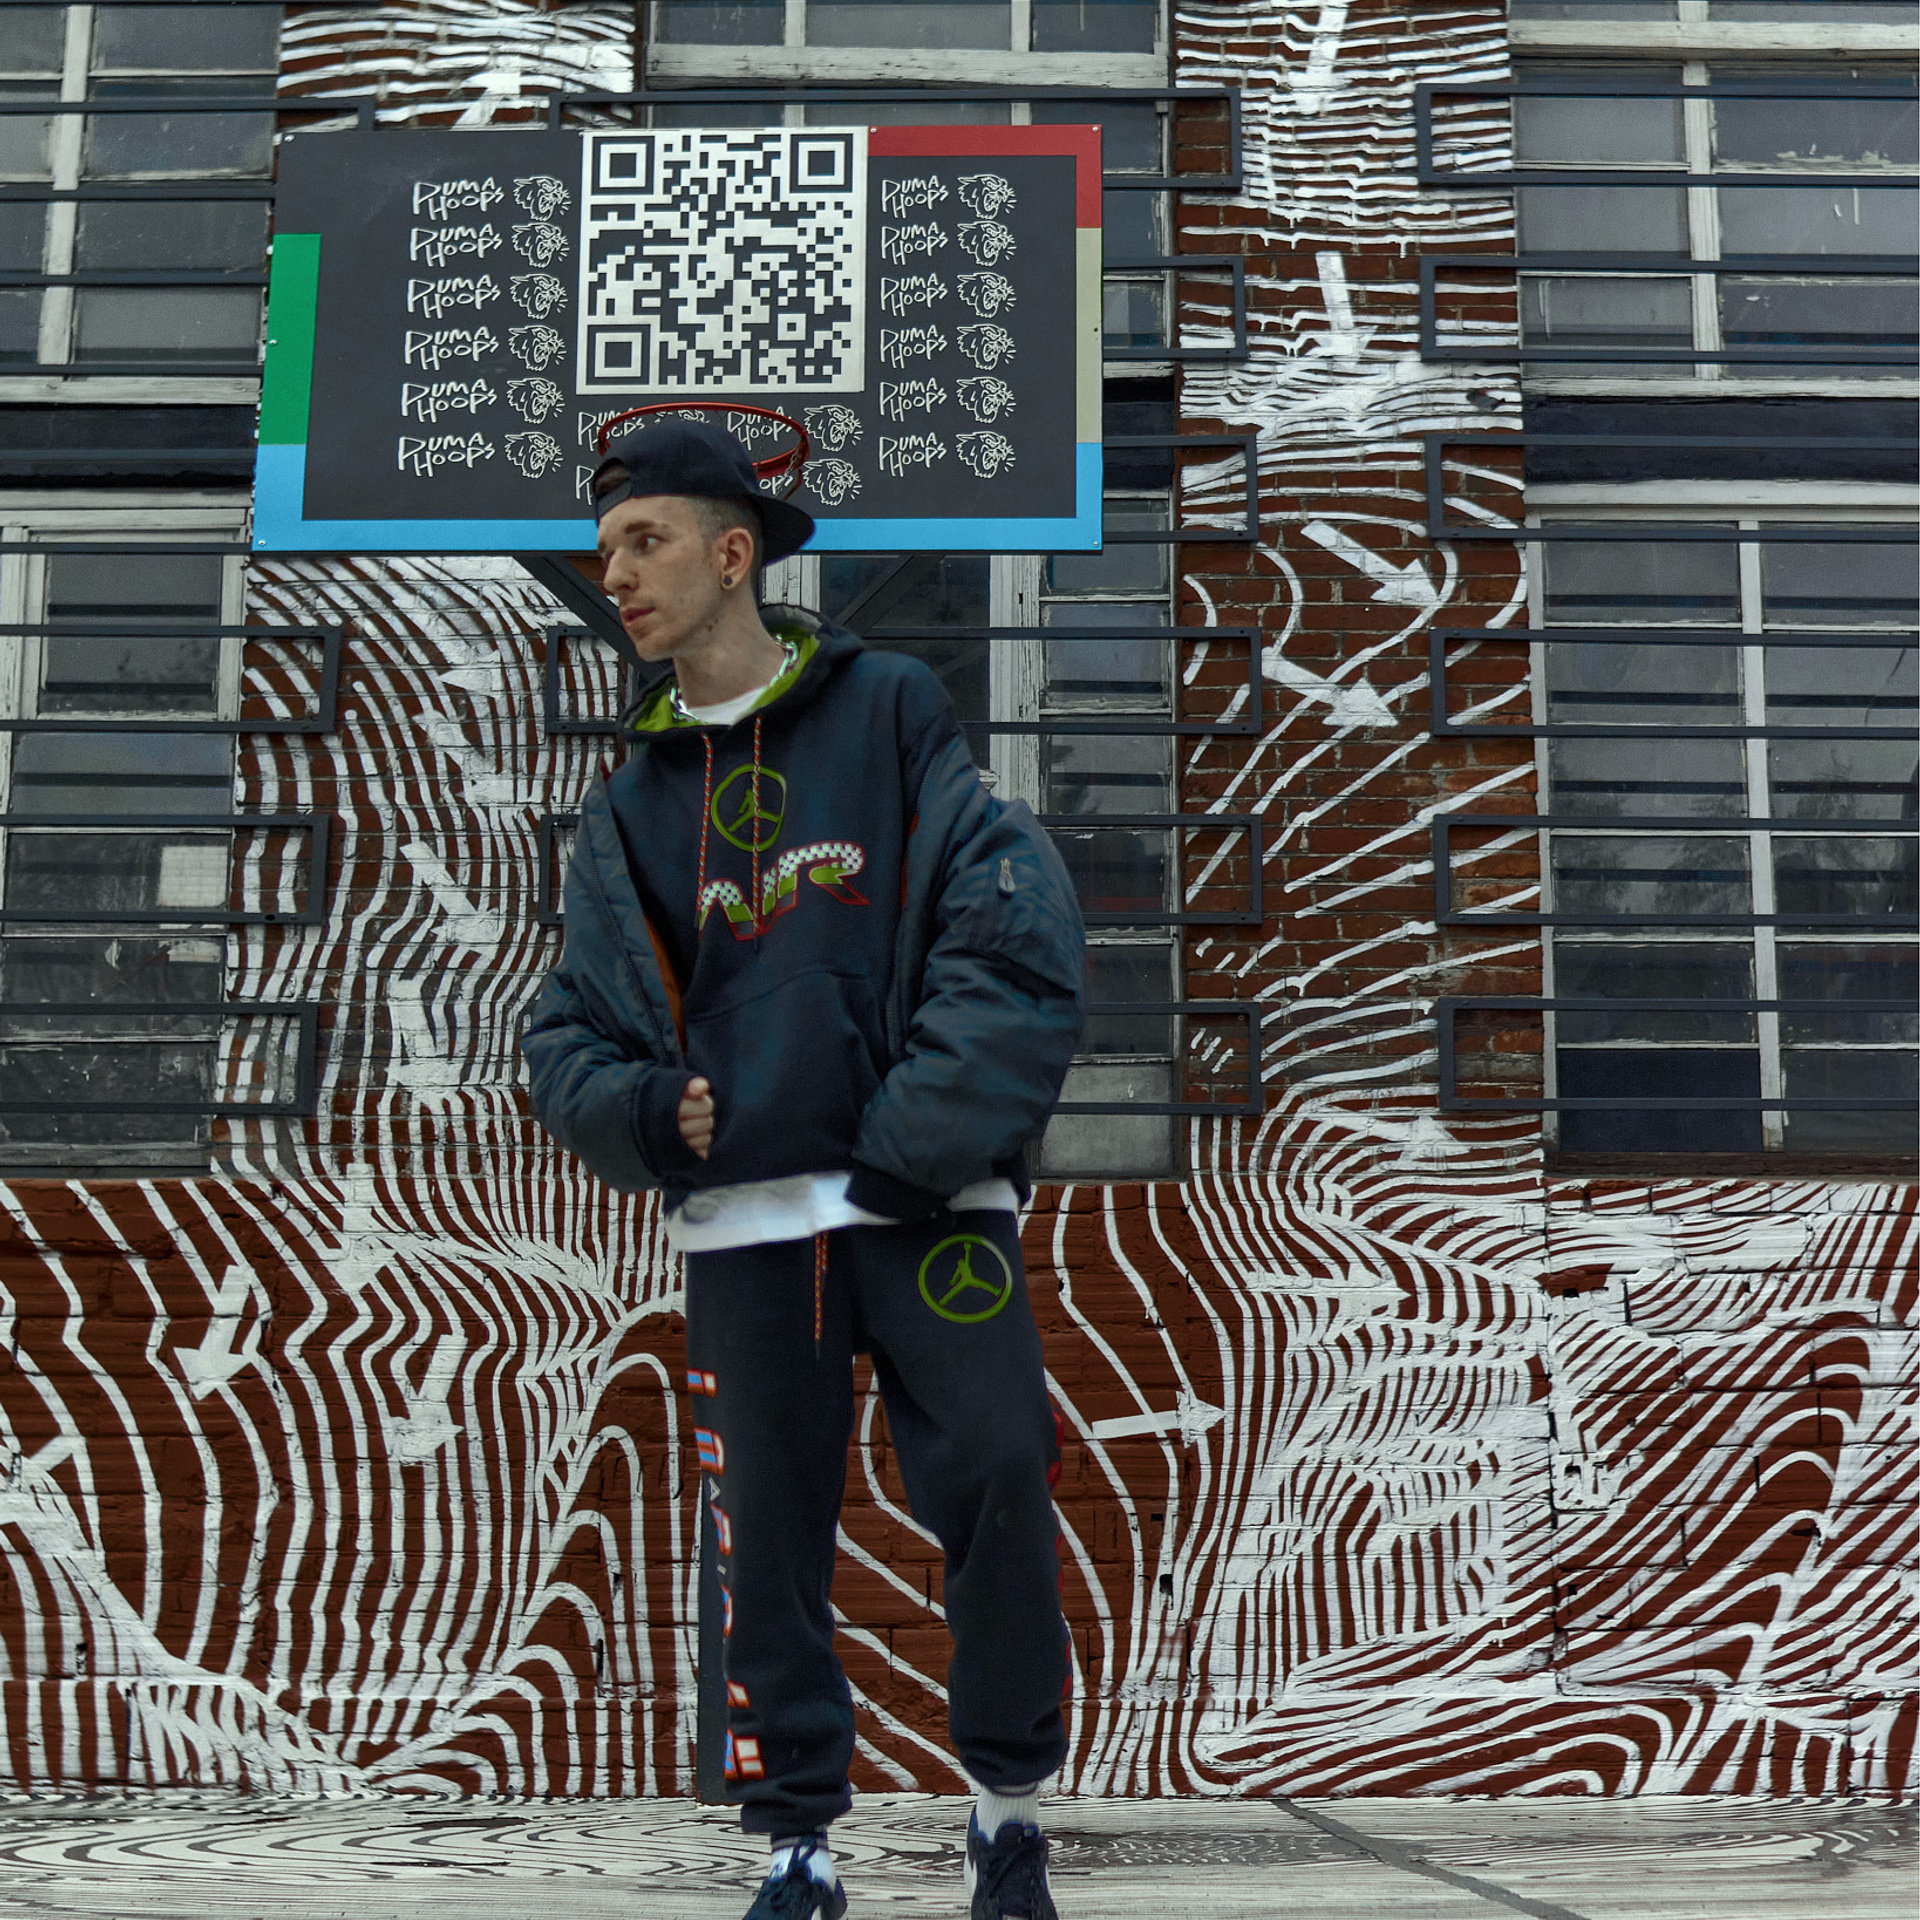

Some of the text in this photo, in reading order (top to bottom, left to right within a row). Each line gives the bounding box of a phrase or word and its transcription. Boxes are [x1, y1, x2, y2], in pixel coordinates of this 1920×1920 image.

[412, 176, 496, 215] PUMA
[428, 187, 505, 221] HOOPS
[881, 174, 940, 213] PUMA
[891, 184, 950, 219] HOOPS
[409, 222, 494, 262] PUMA
[424, 233, 503, 268] HOOPS
[880, 221, 940, 260] PUMA
[891, 231, 949, 266] HOOPS
[406, 274, 492, 313] PUMA
[422, 284, 502, 320] HOOPS
[880, 272, 939, 311] PUMA
[890, 282, 949, 317] HOOPS
[404, 325, 490, 365] PUMA
[419, 336, 500, 371] HOOPS
[879, 324, 939, 363] PUMA
[890, 334, 948, 369] HOOPS
[401, 378, 488, 417] PUMA
[416, 388, 498, 423] HOOPS
[879, 377, 938, 416] PUMA
[889, 387, 948, 423] HOOPS
[397, 432, 485, 471] PUMA
[413, 443, 496, 478] HOOPS
[878, 431, 938, 471] PUMA
[889, 442, 947, 478] HOOPS
